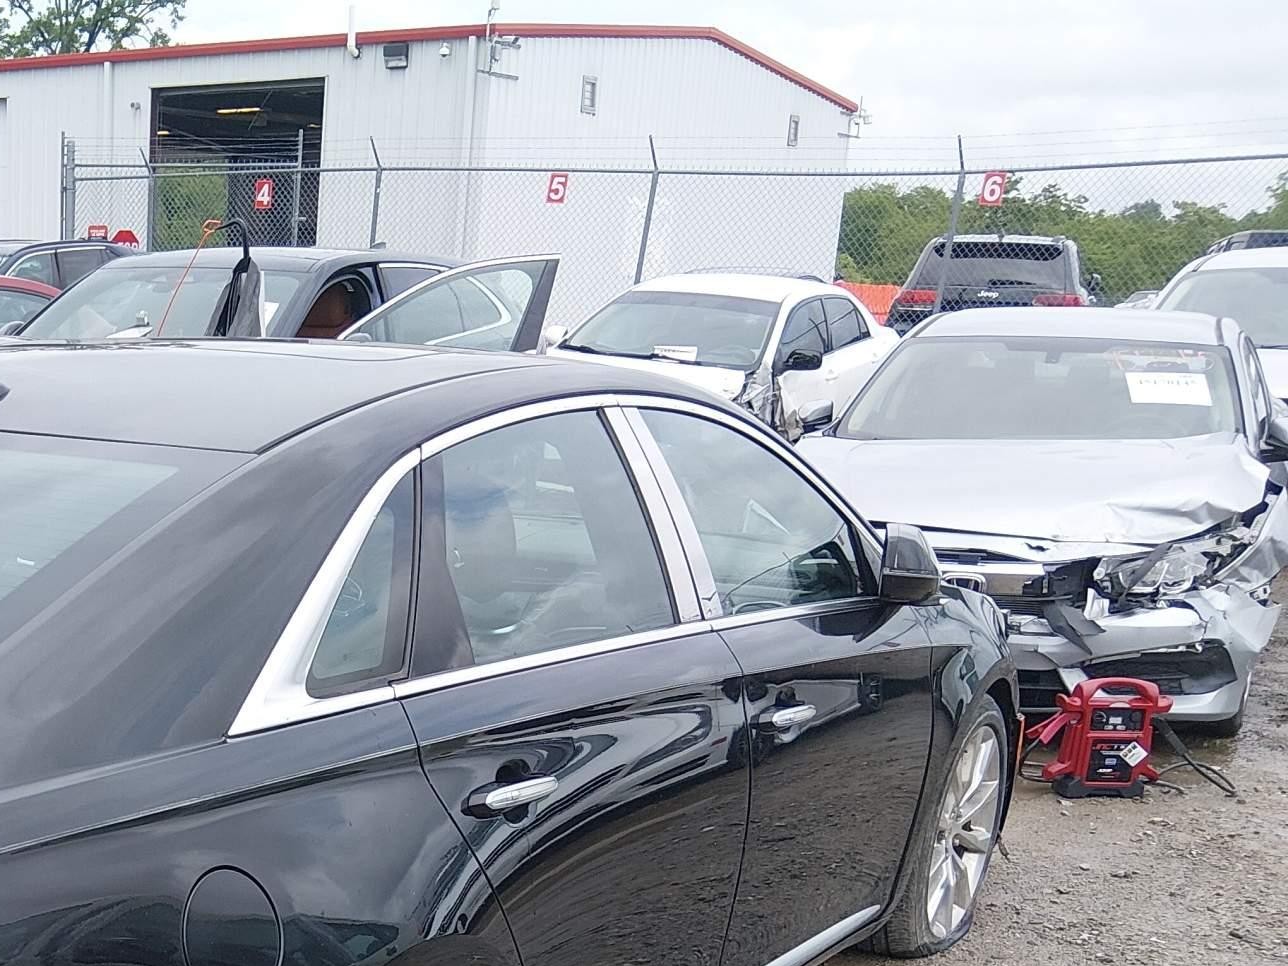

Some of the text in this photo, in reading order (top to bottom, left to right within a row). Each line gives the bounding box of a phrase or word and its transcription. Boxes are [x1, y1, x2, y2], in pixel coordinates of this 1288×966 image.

[256, 183, 270, 205] 4
[550, 177, 566, 201] 5
[983, 176, 1003, 202] 6
[977, 290, 999, 299] Jeep
